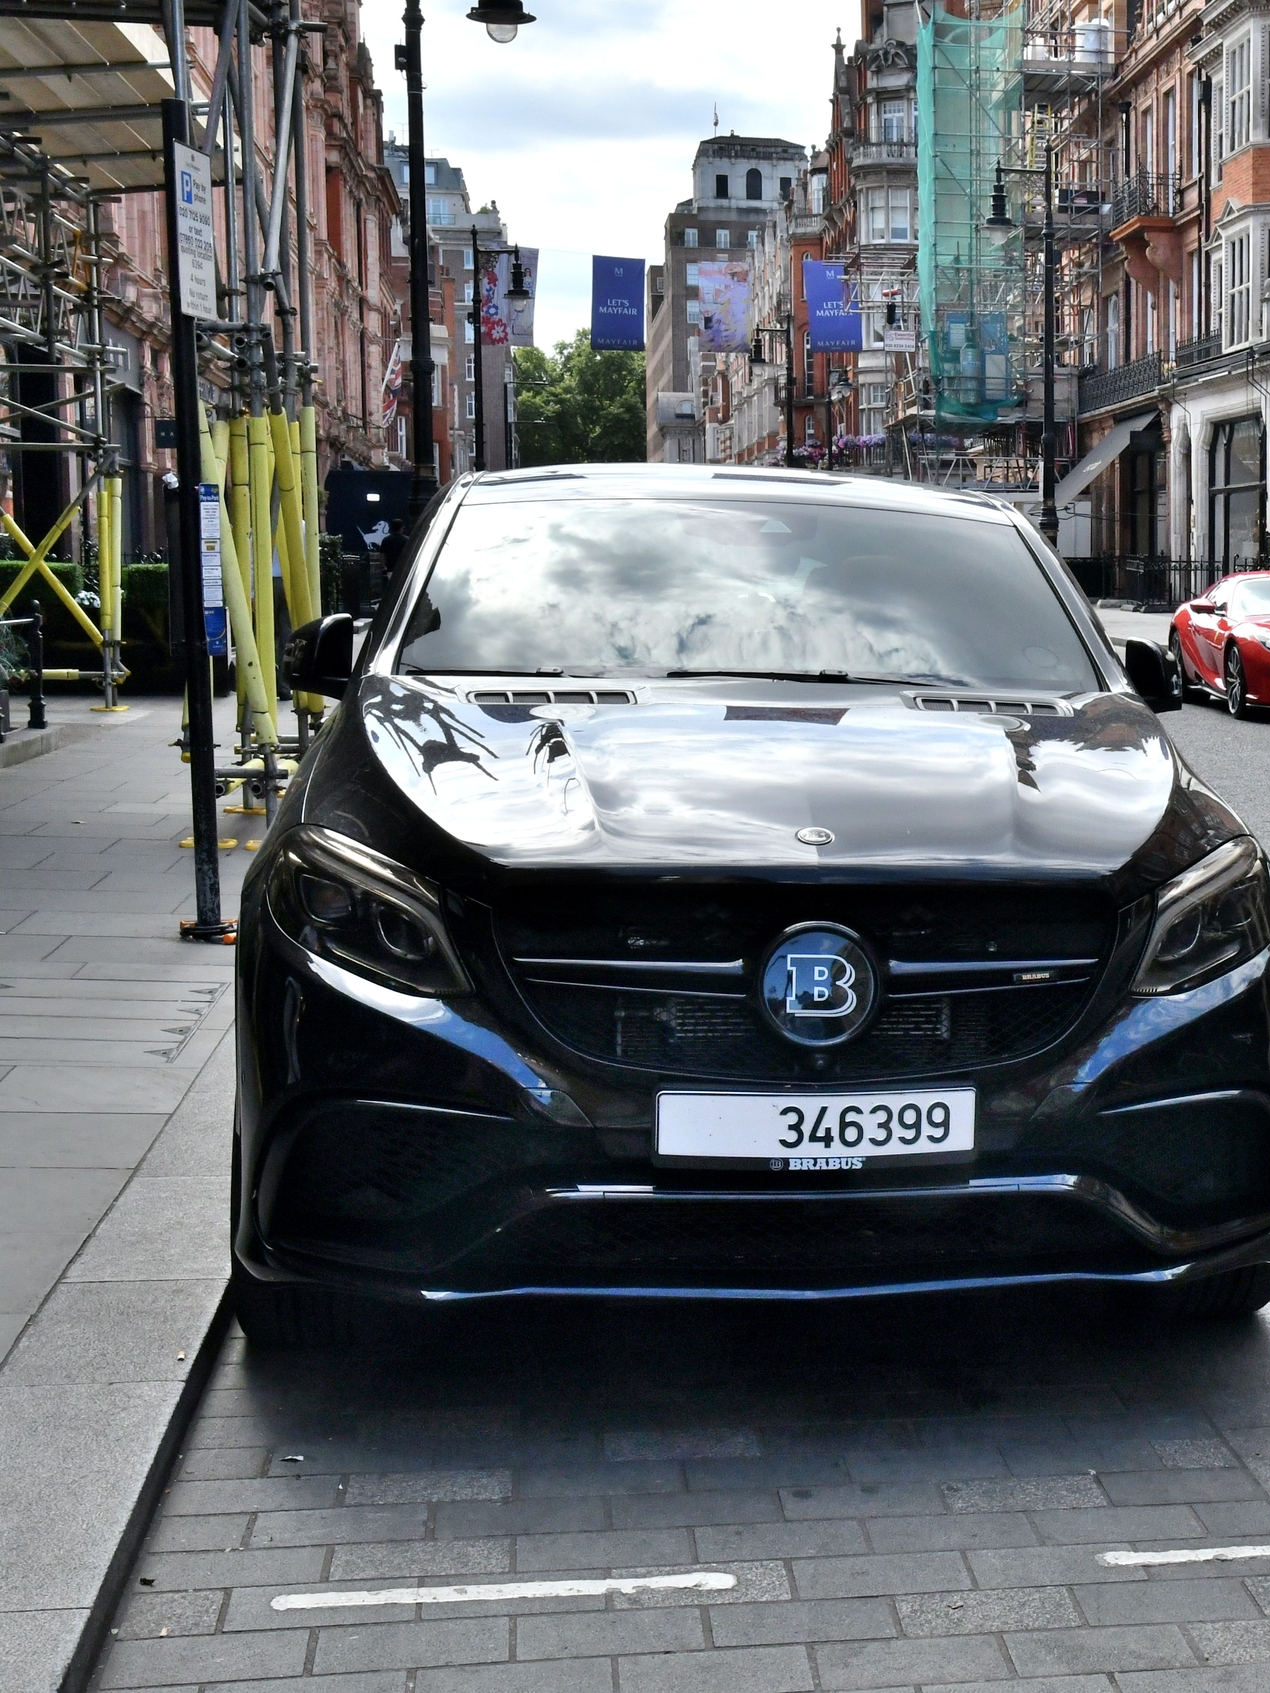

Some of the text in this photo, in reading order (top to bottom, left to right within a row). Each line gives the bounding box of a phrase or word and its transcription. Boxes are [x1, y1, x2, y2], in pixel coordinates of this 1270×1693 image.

[184, 174, 191, 200] P
[201, 184, 206, 194] by
[194, 193, 206, 204] phone
[180, 206, 210, 226] 020 7125 9090
[194, 226, 202, 237] text
[181, 246, 212, 261] quoting location
[194, 275, 206, 286] hours
[189, 288, 195, 298] No
[607, 299, 629, 307] LET'S
[599, 306, 637, 315] MAYFAIR
[778, 1101, 950, 1149] 346399
[788, 1157, 862, 1170] BRABUS
